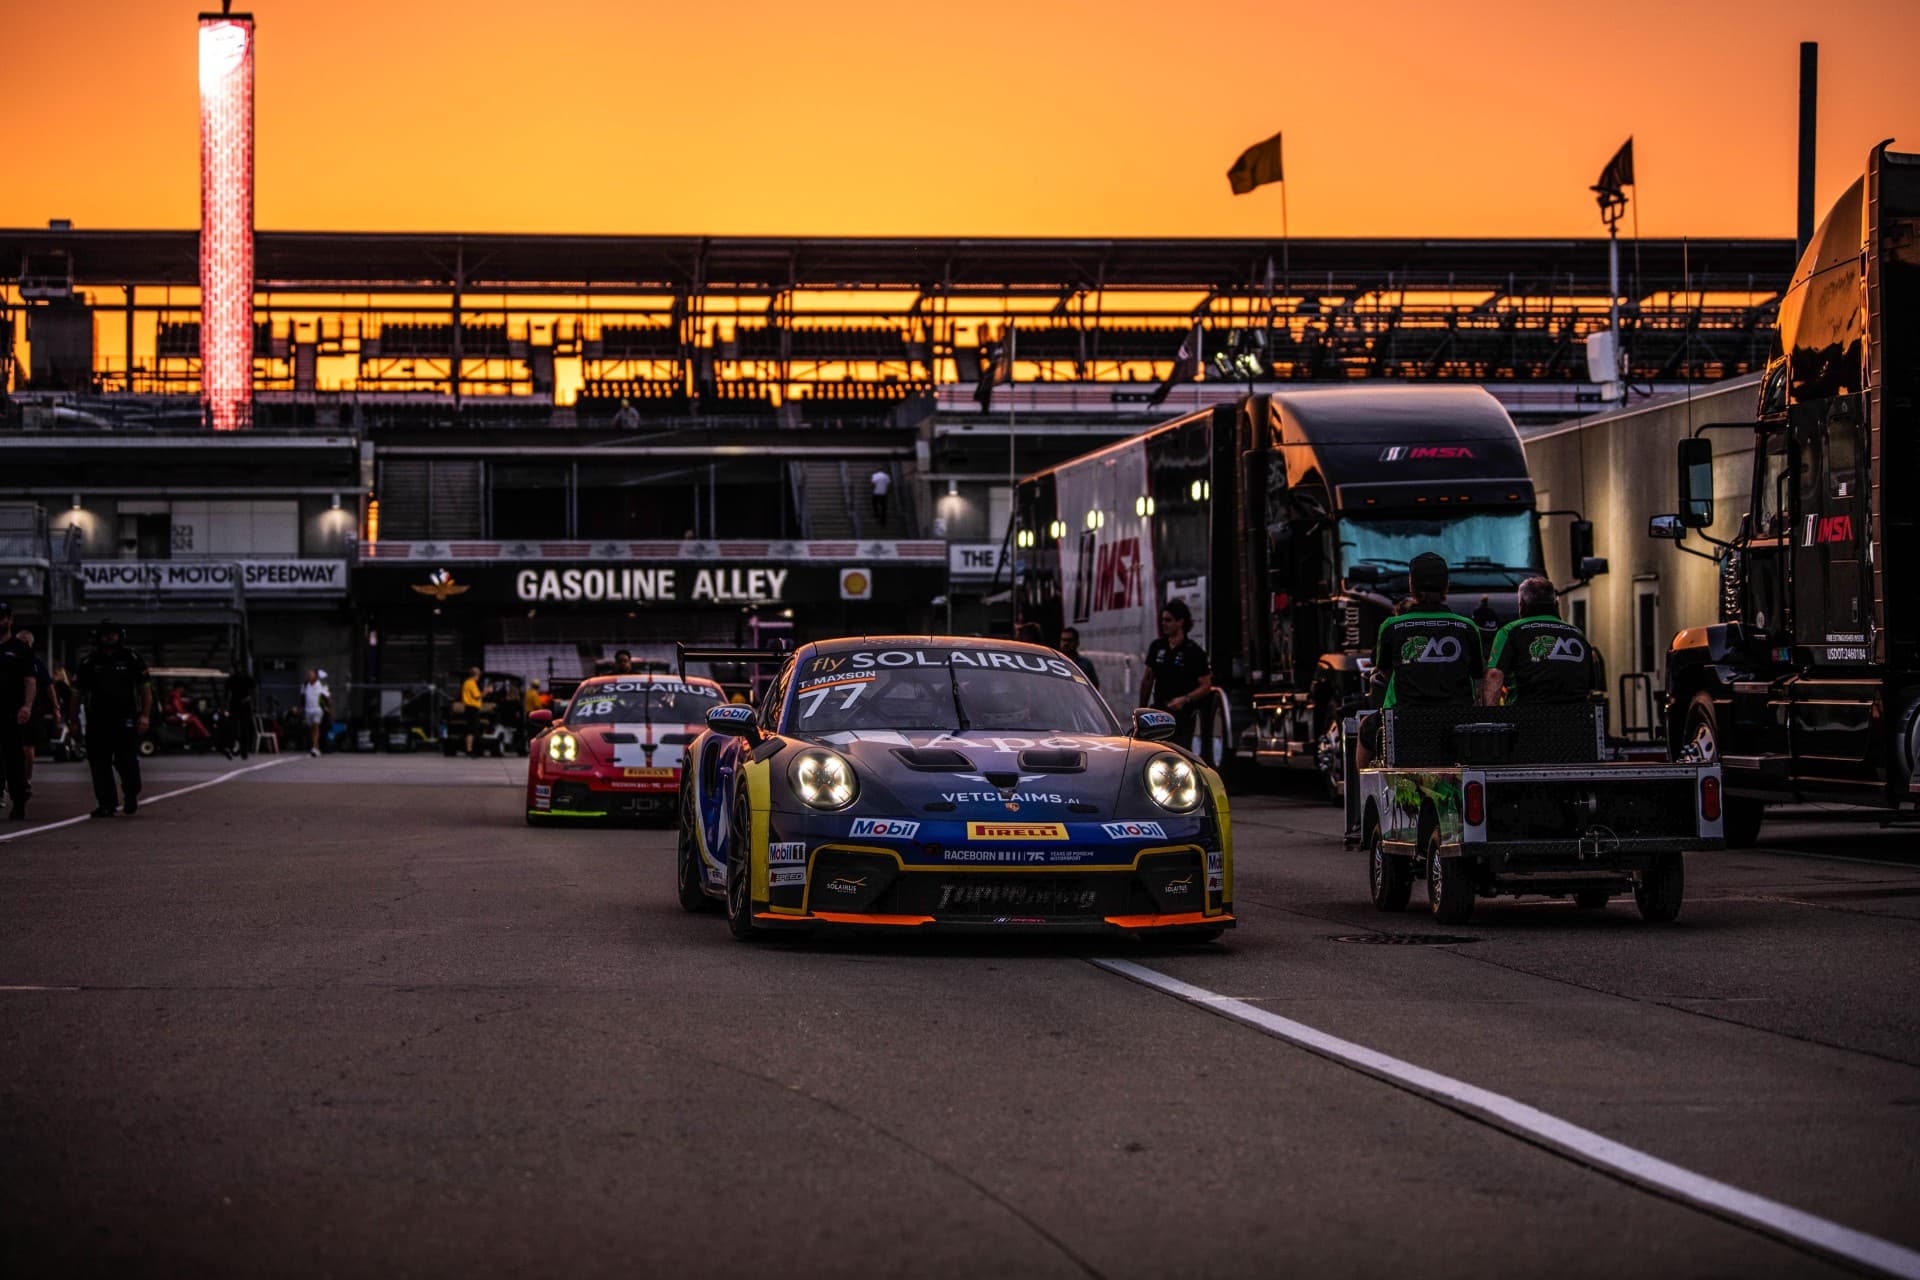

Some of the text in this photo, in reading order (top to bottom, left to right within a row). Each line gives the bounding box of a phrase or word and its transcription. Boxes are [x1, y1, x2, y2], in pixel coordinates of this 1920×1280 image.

[1410, 447, 1474, 459] IMSA
[1816, 515, 1855, 543] IMSA
[962, 549, 994, 567] THE
[245, 564, 336, 583] SPEEDWAY
[1093, 537, 1143, 613] IMSA
[516, 568, 788, 601] GASOLINE ALLEY
[1394, 620, 1468, 630] PORSCHE
[812, 650, 1072, 678] fly SOLAIRUS
[814, 669, 876, 687] MAXSON
[602, 682, 718, 698] SOLAIRUS
[576, 700, 614, 718] 48
[798, 682, 867, 719] 77
[710, 708, 749, 719] Mobil
[918, 733, 1124, 753] Apex
[854, 820, 916, 837] Mobil
[975, 824, 1058, 837] PIRELLI
[1107, 823, 1163, 837] Mobil
[770, 845, 792, 860] Mobil
[944, 850, 1045, 861] RACEBORN 75
